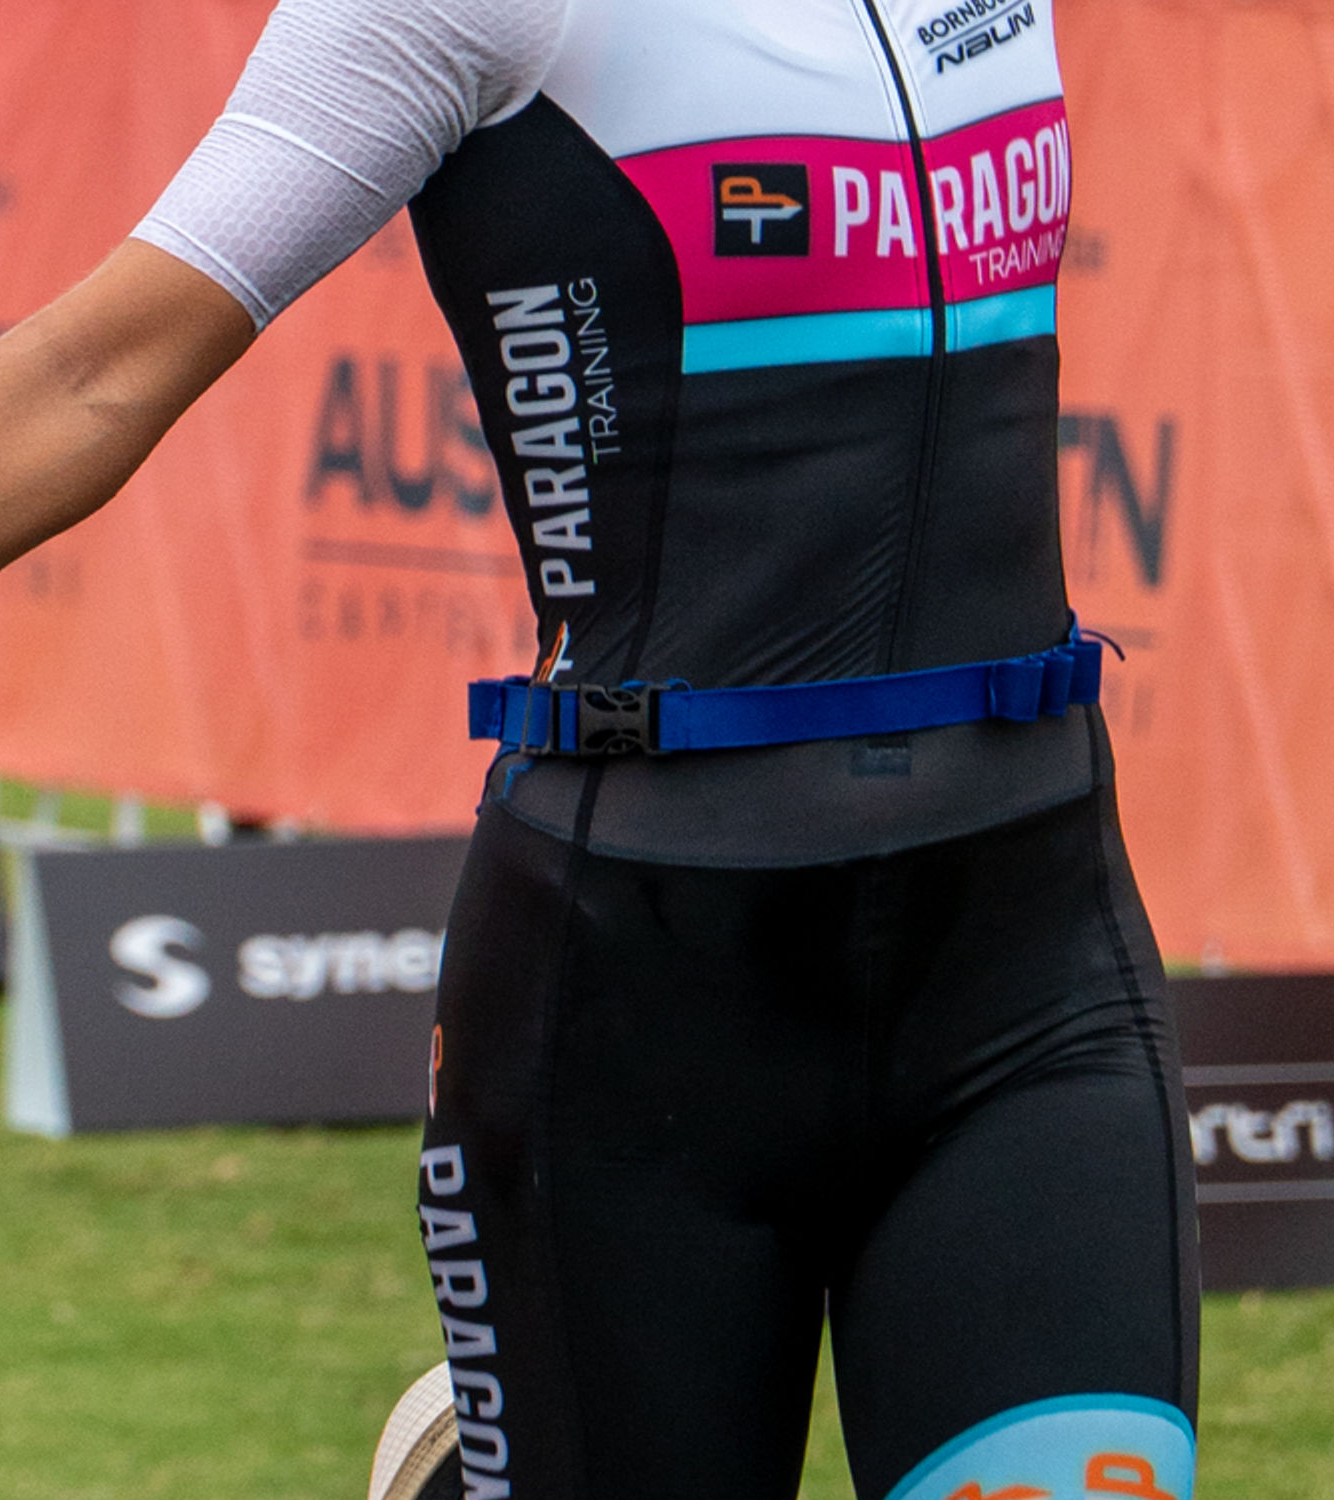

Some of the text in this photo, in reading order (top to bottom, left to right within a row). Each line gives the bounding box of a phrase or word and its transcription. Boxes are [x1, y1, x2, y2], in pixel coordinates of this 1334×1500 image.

[832, 117, 1069, 258] PARAGON
[300, 350, 502, 518] AUS
[486, 283, 596, 597] PARAGON
[568, 277, 621, 465] TRAINING
[237, 926, 446, 1002] syne
